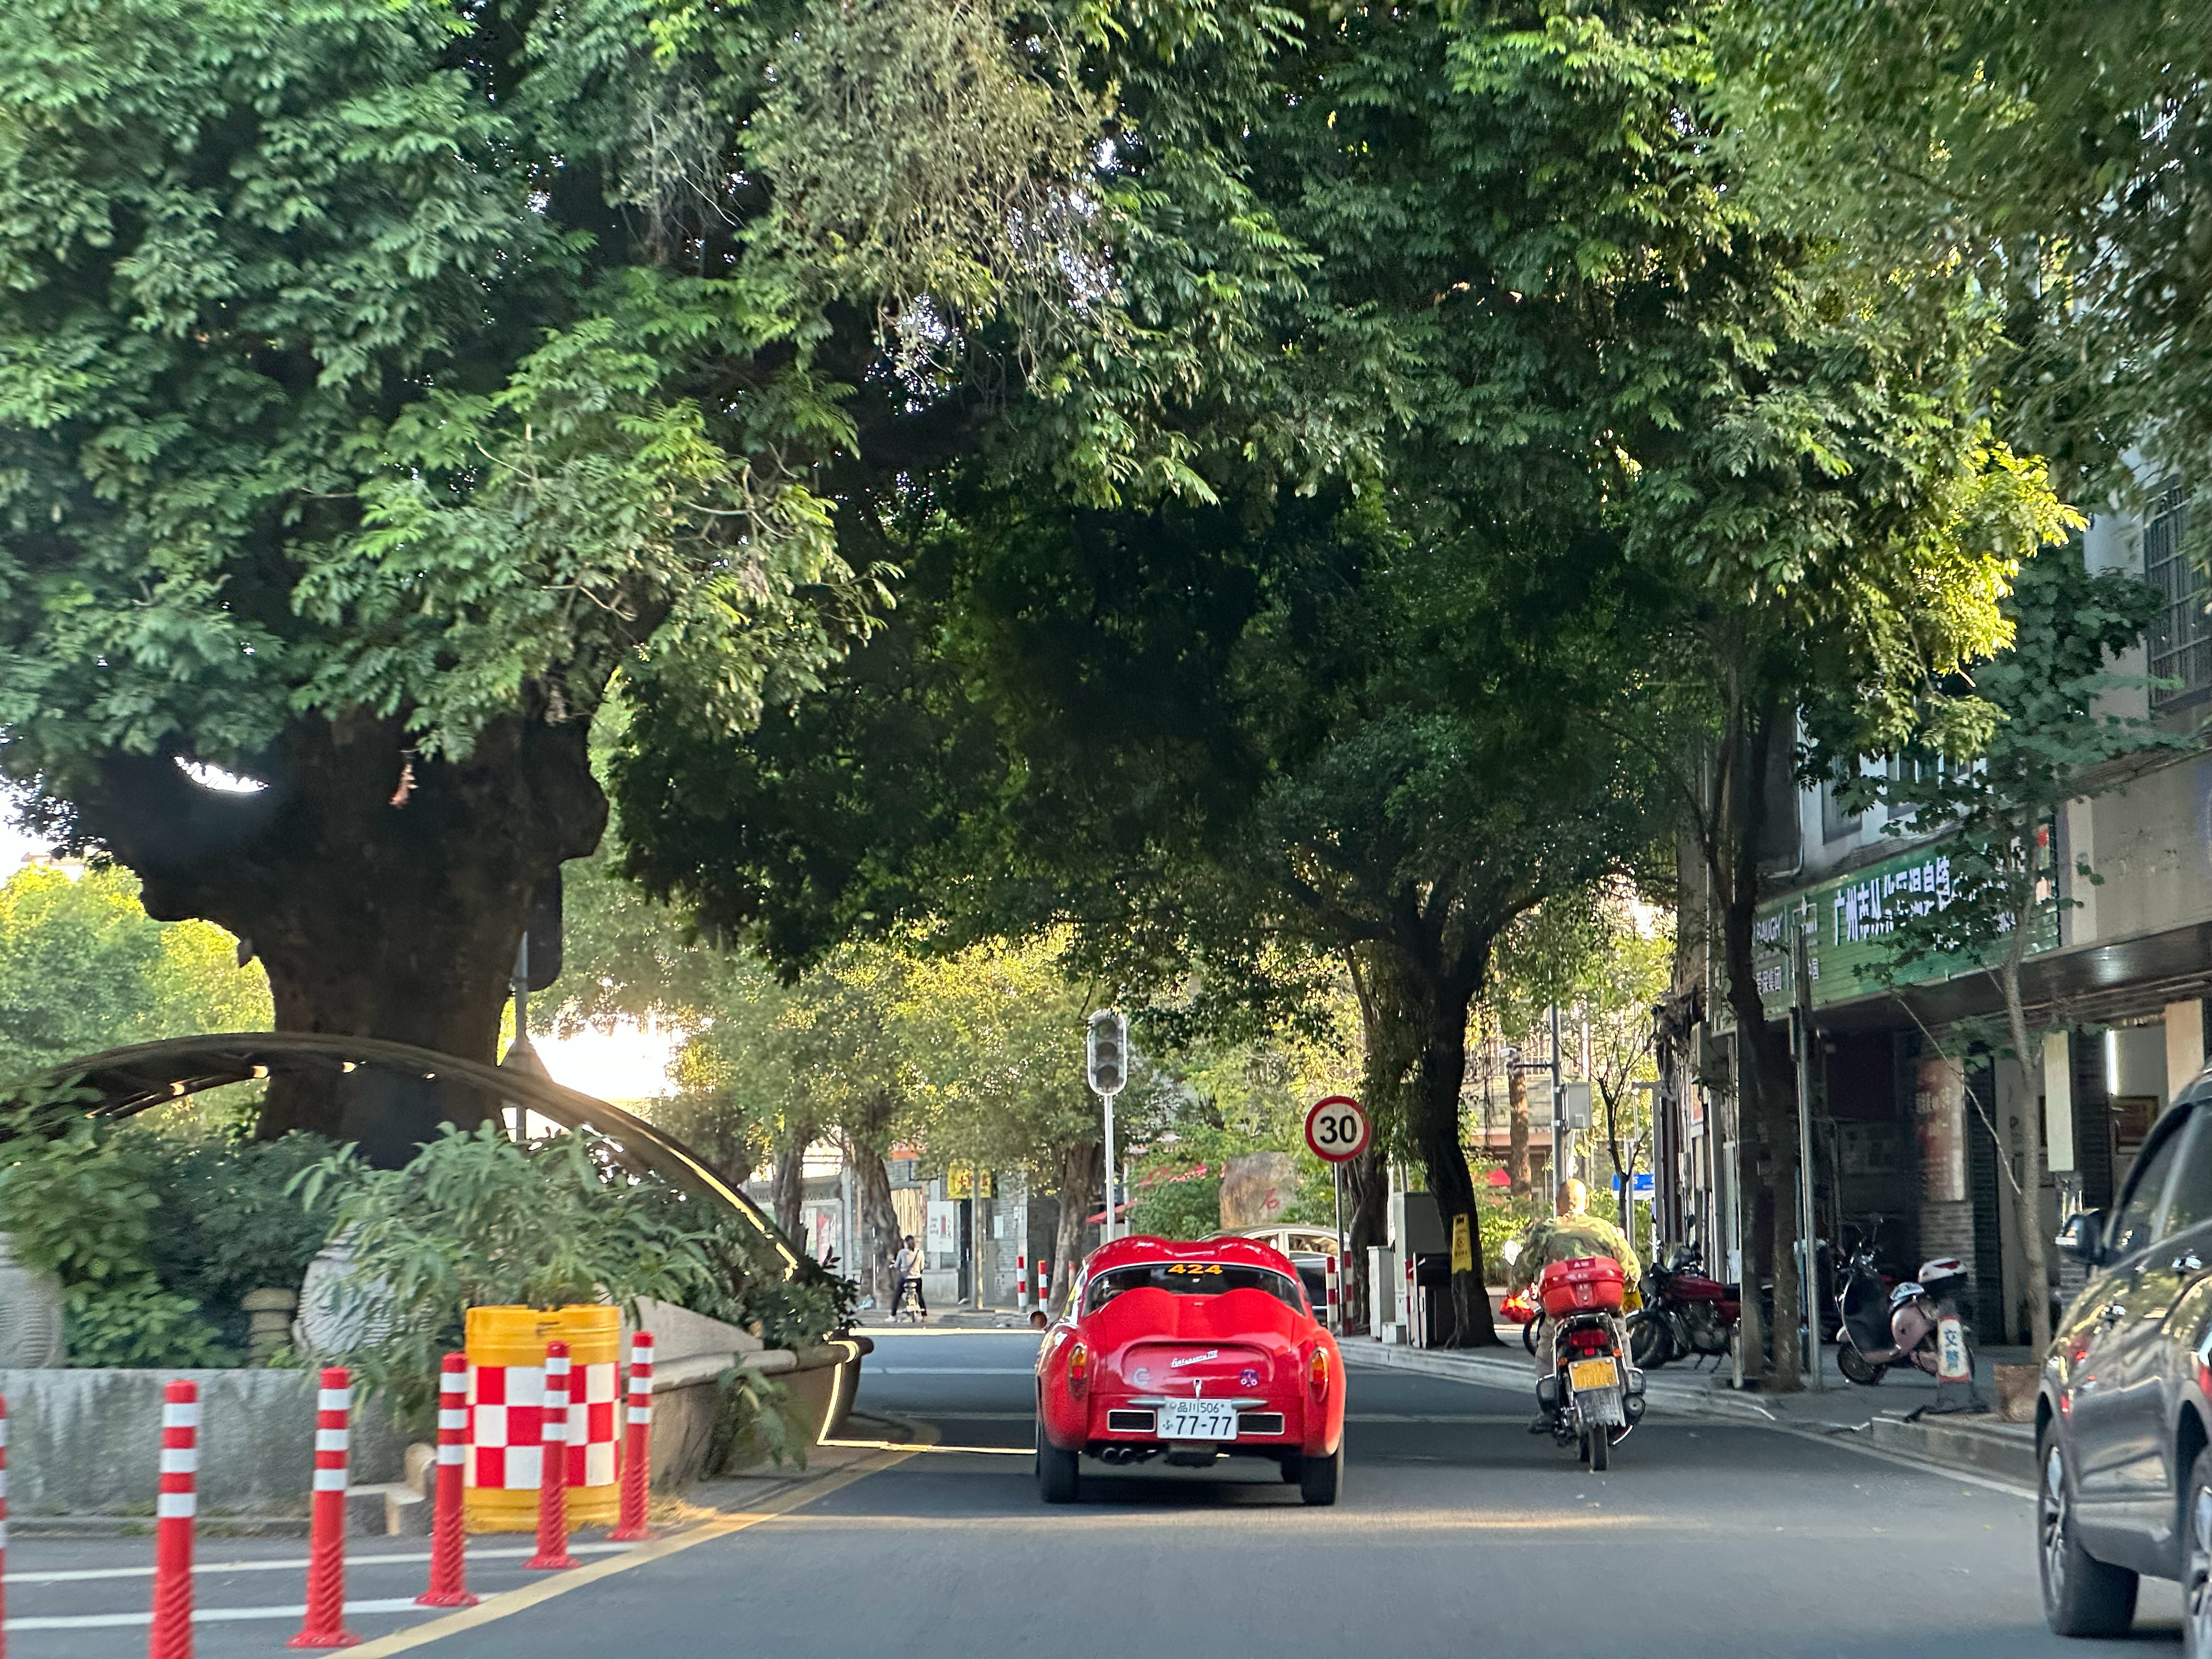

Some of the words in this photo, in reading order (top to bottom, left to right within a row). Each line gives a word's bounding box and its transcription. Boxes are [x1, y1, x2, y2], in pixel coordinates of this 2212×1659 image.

[1319, 1115, 1357, 1143] 30
[1167, 1263, 1223, 1274] 424
[1176, 1415, 1232, 1436] 77-77
